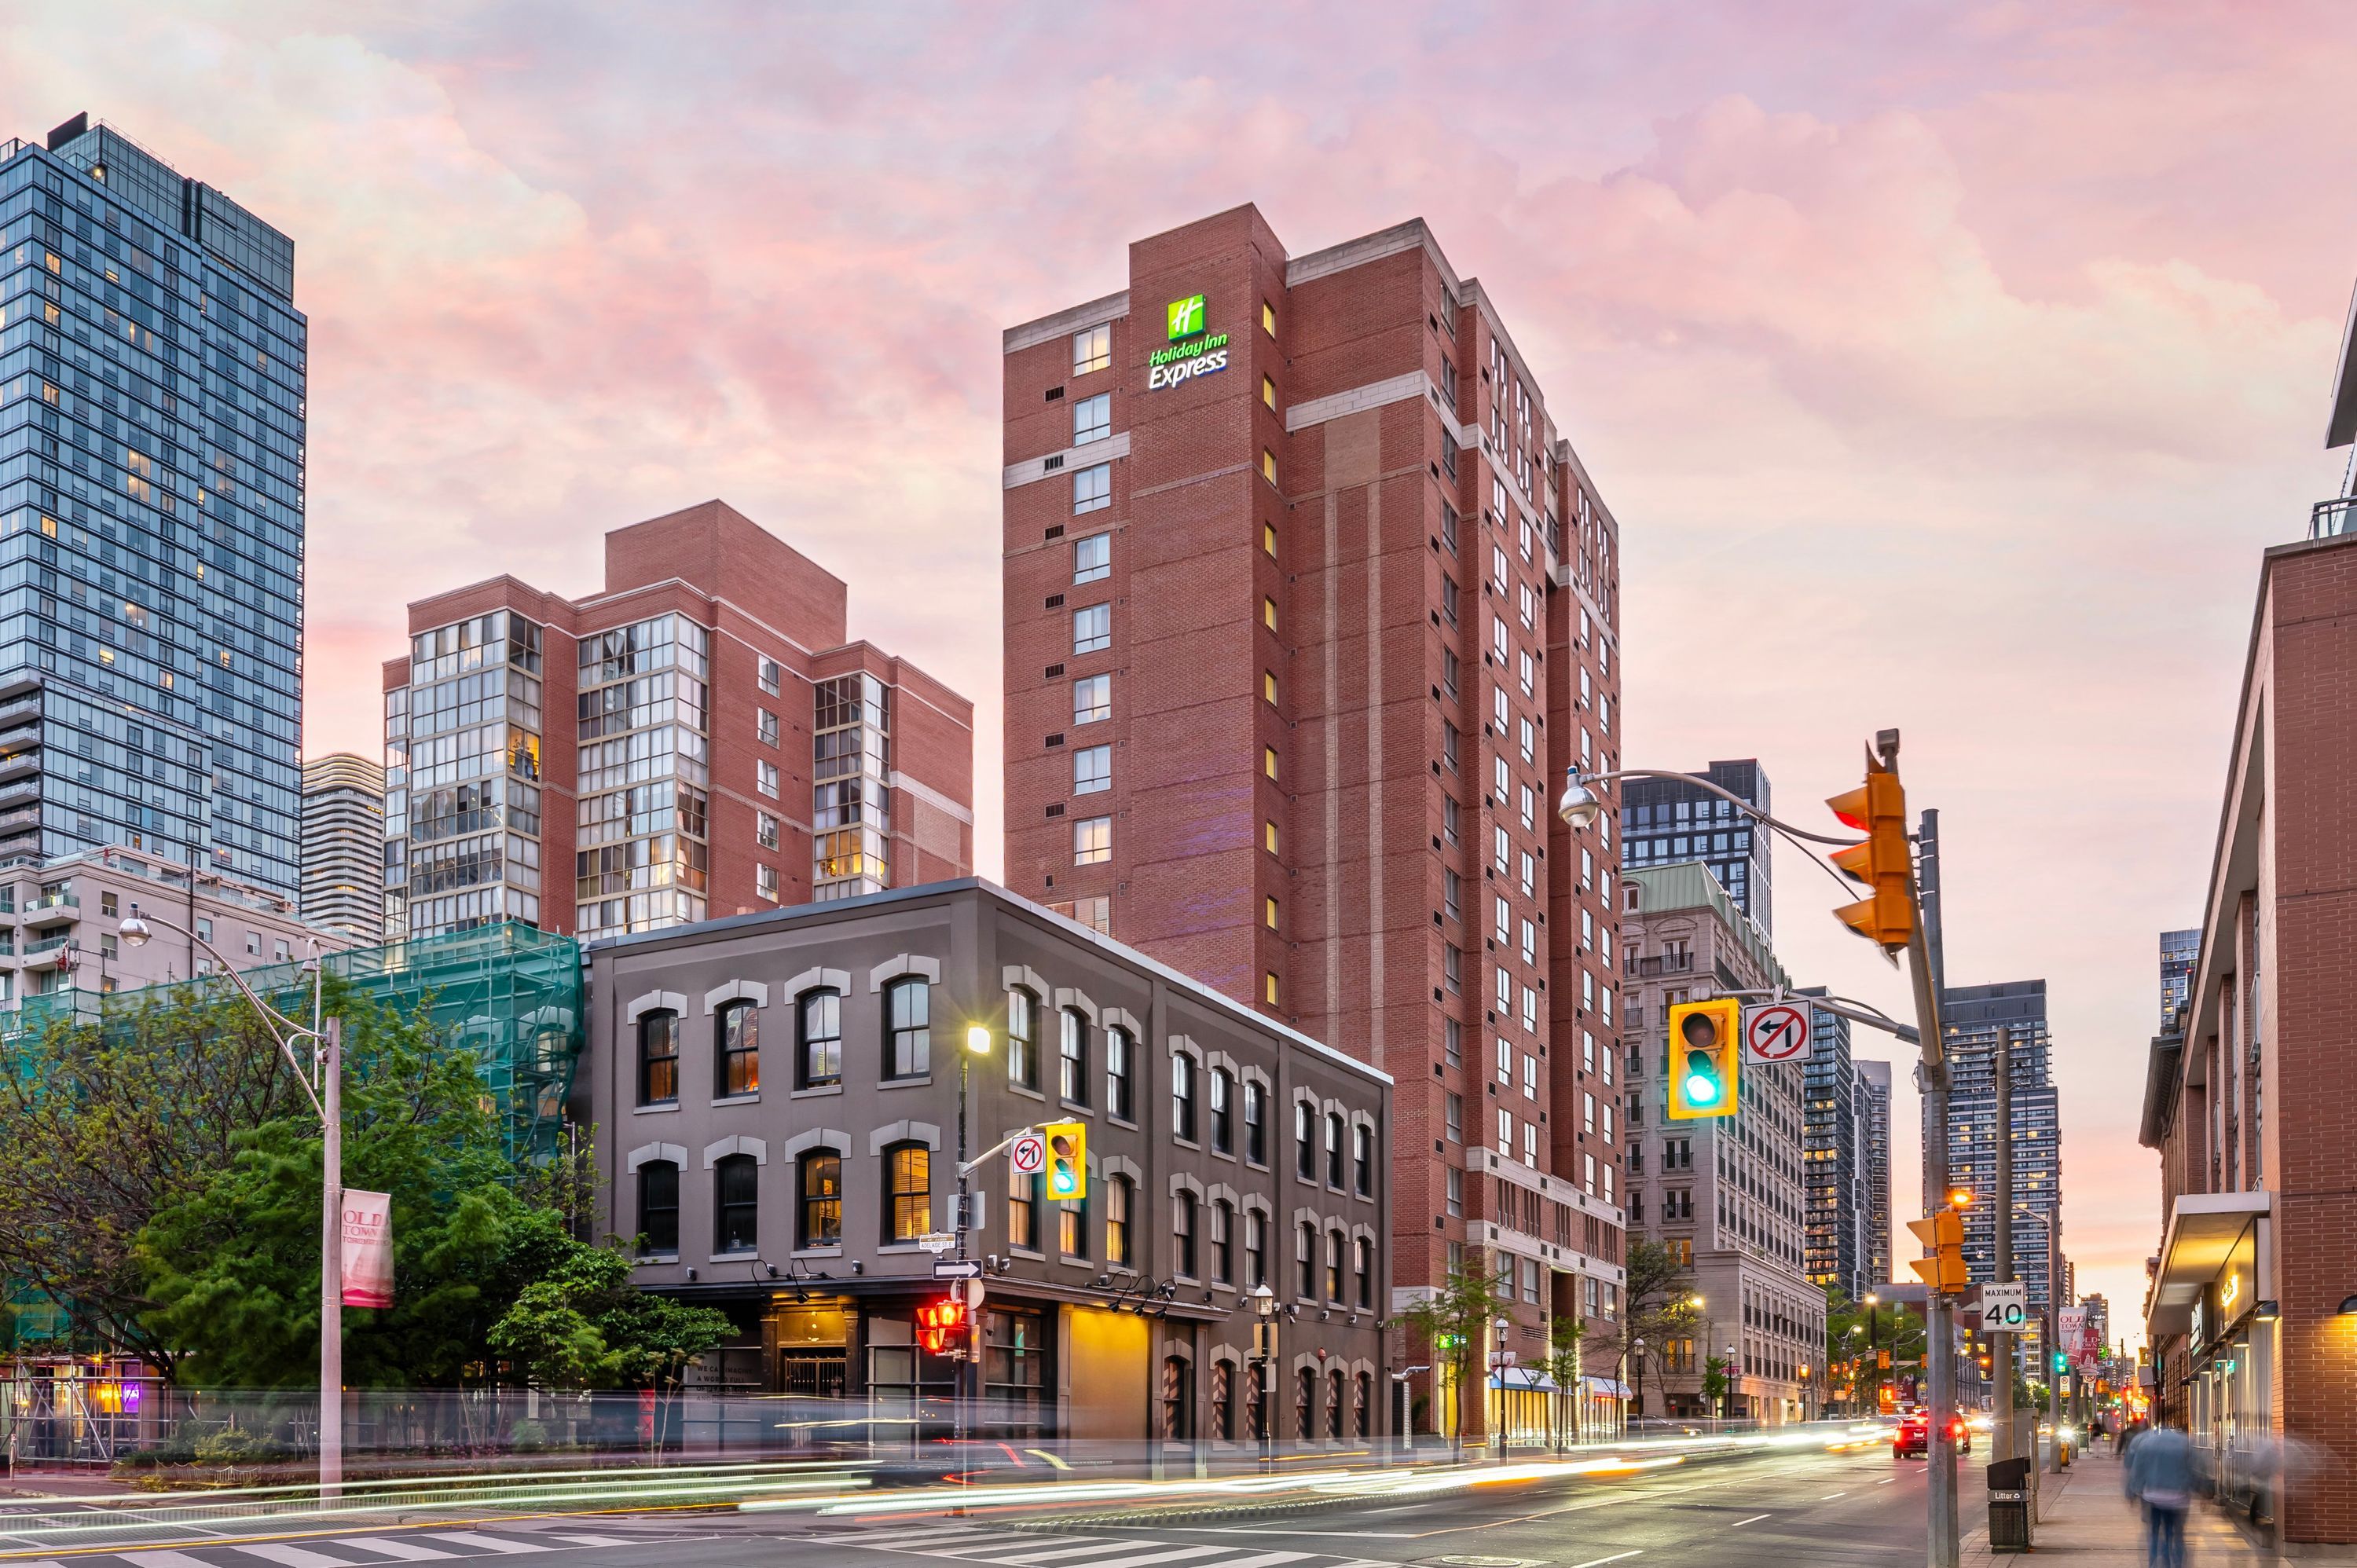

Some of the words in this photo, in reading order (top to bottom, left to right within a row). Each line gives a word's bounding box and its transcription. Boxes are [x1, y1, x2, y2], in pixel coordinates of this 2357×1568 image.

[1149, 342, 1204, 368] Holiday
[1204, 334, 1228, 351] Inn
[1149, 350, 1228, 390] Express
[343, 1210, 383, 1227] OLD
[1985, 1303, 2022, 1325] 40
